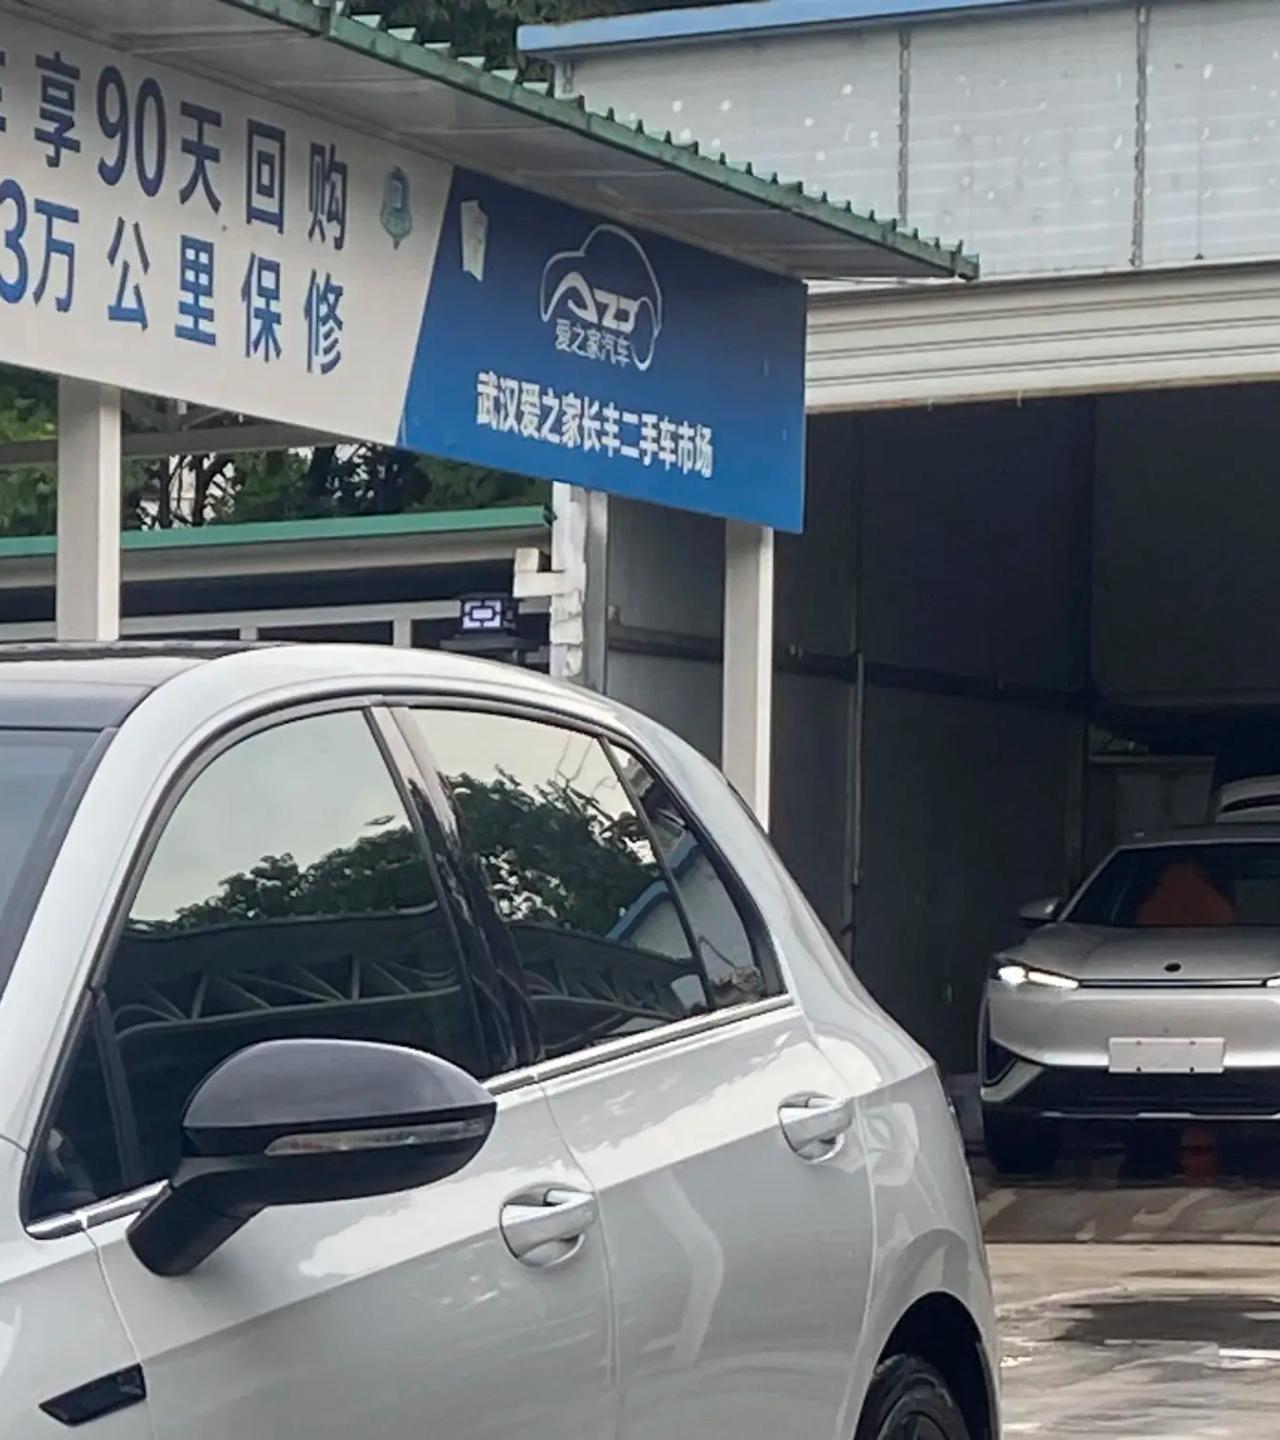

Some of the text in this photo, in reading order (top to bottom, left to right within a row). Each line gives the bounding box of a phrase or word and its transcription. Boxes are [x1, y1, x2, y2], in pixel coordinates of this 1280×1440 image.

[554, 317, 631, 368] 爱之家汽车
[475, 370, 714, 479] 武汉爱之家长丰二手车市场
